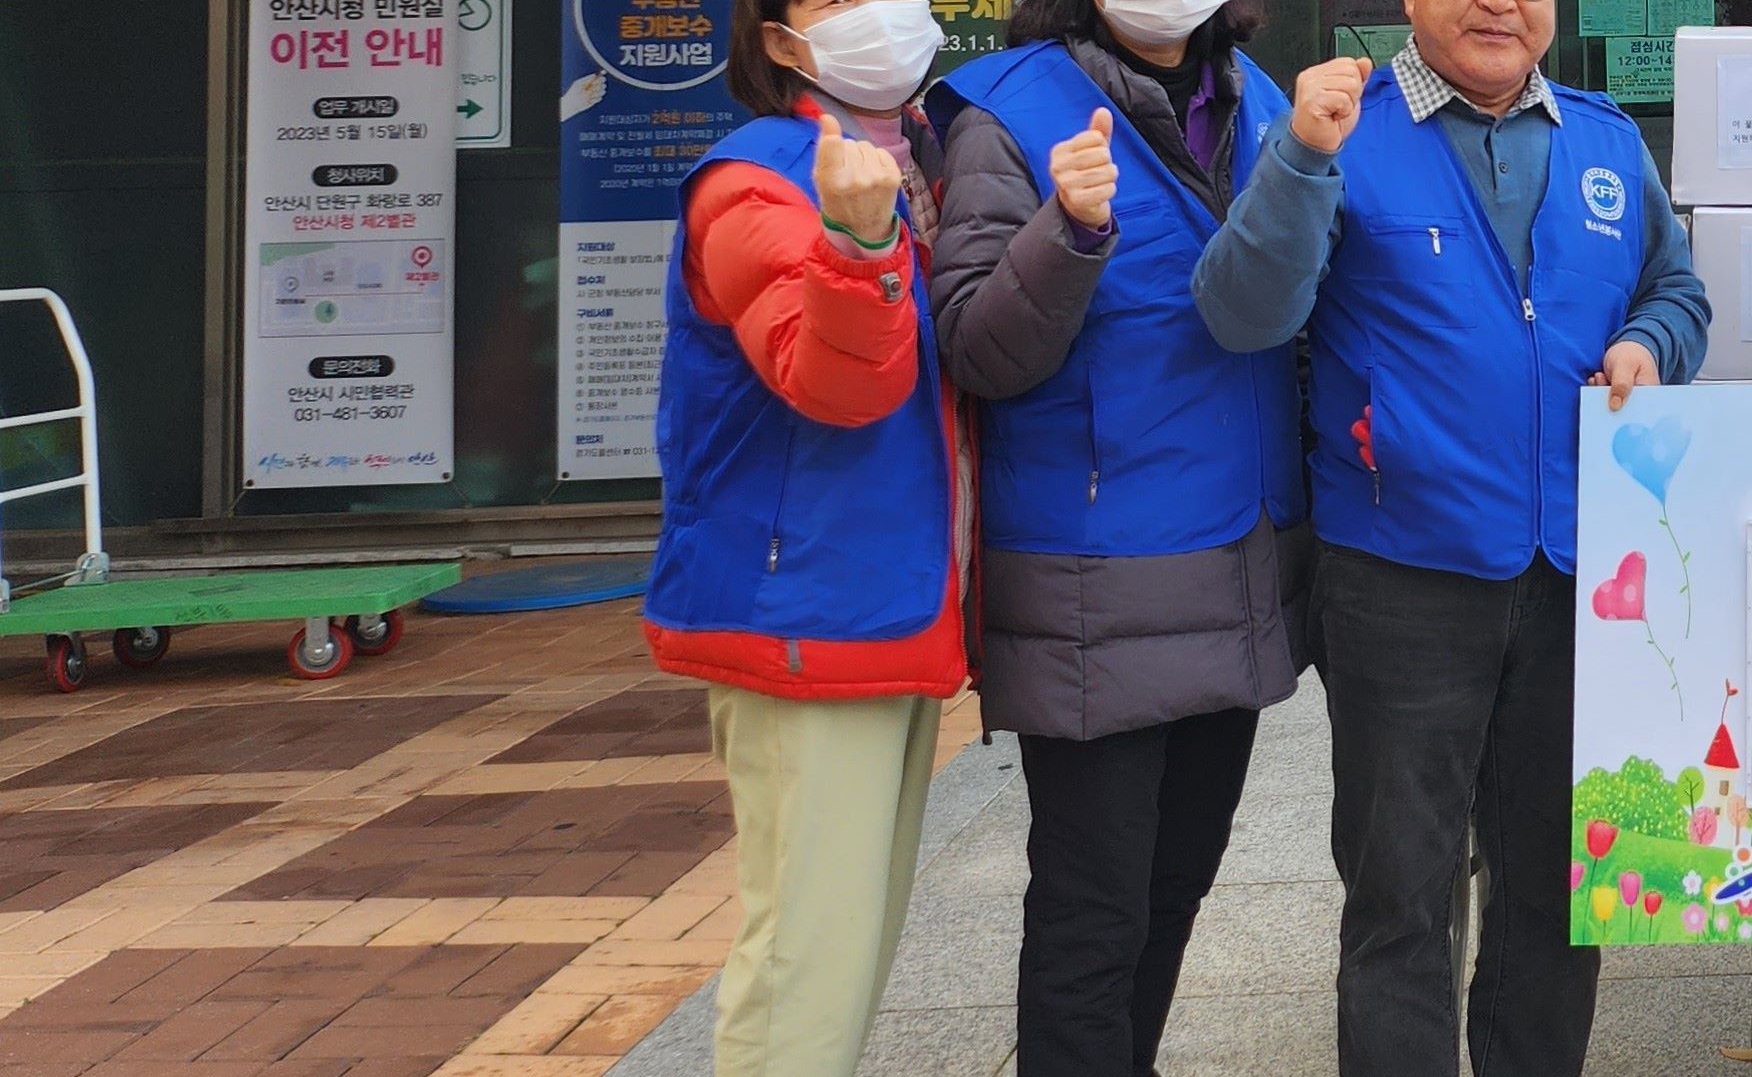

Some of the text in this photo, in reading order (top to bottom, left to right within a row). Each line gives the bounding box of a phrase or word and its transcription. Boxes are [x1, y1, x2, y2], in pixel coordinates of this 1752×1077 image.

[619, 13, 713, 39] 중개보수
[270, 27, 444, 70] 이전 안내
[619, 42, 713, 66] 지원사업
[320, 98, 396, 116] 업무 개시일
[277, 123, 428, 141] 2023년 5월 15일(월)
[327, 167, 385, 184] 청사위치
[264, 193, 444, 213] 안산시 단원구 화랑로 387
[293, 213, 417, 231] 안산시청 제2별관
[323, 358, 382, 375] 문의전화
[287, 384, 415, 403] 안산시 시민협력관
[293, 404, 407, 423] 031-481-3607
